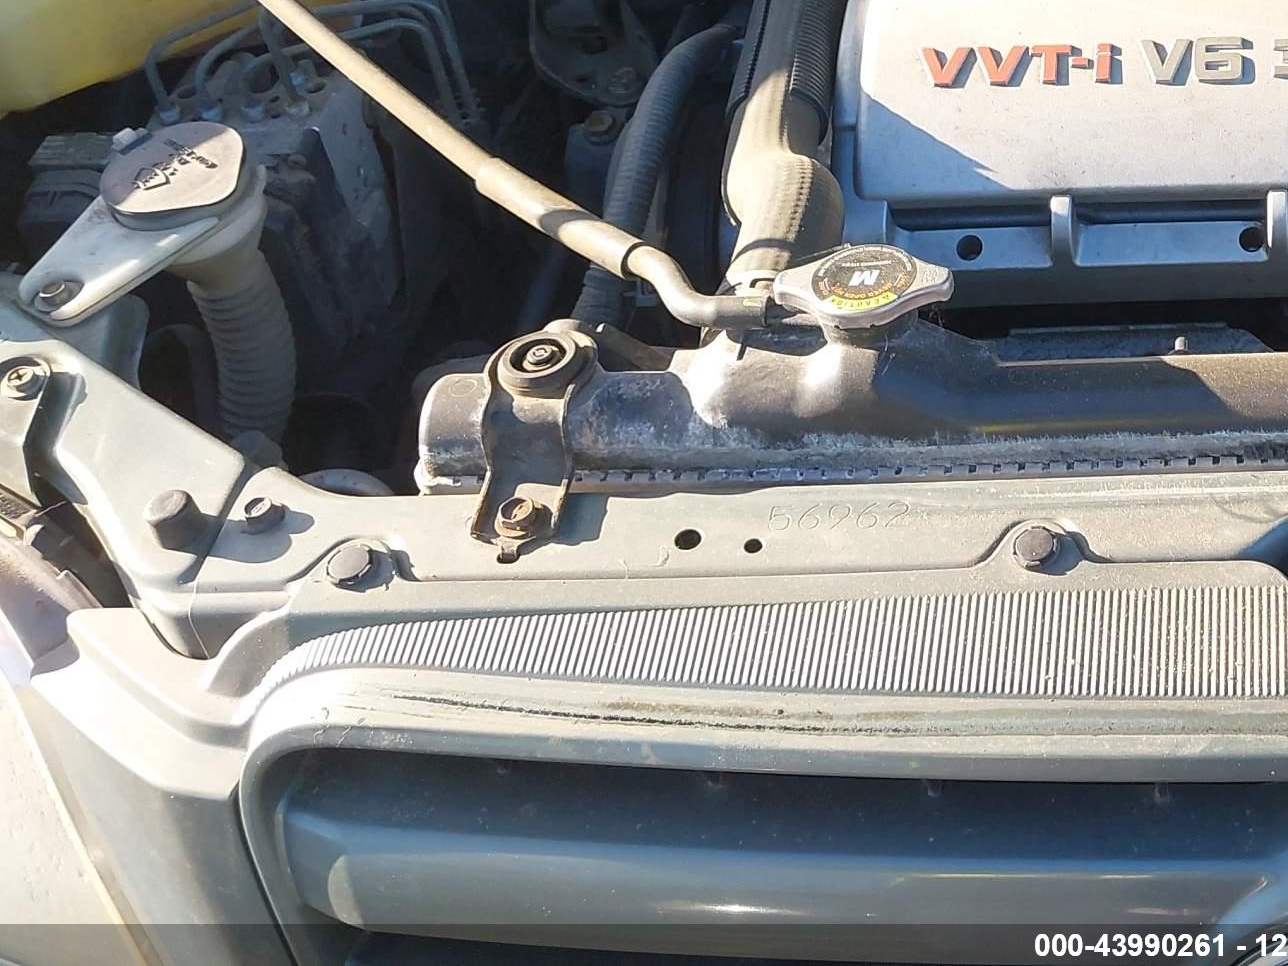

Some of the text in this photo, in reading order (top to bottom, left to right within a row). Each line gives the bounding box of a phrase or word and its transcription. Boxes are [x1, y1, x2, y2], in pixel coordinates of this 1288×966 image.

[920, 39, 1122, 87] VVT-i
[1138, 35, 1256, 86] V6
[767, 497, 911, 531] 56962
